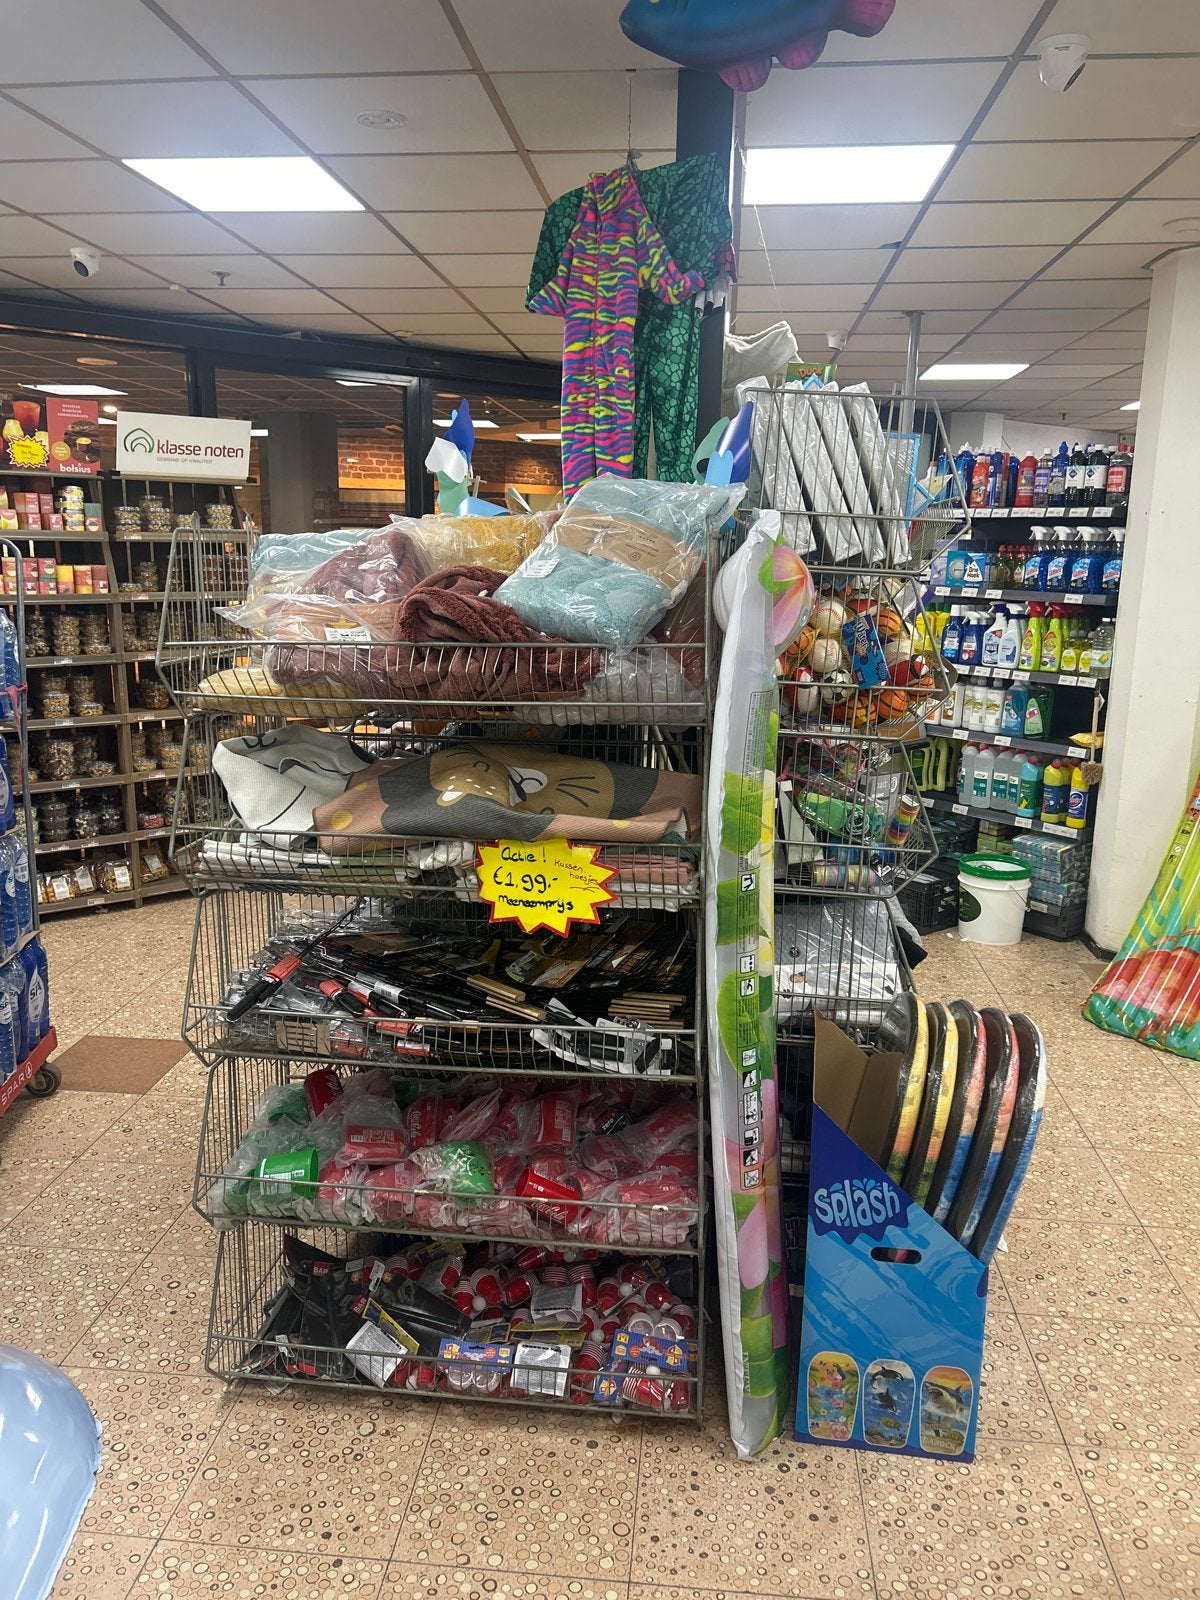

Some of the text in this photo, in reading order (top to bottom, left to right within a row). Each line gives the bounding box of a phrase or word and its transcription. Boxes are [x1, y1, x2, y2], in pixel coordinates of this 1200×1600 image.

[157, 439, 244, 458] klasse noten
[59, 462, 91, 473] bolsius
[1, 1072, 25, 1106] SPAR
[312, 1266, 329, 1275] BAR
[353, 1297, 368, 1314] BAR
